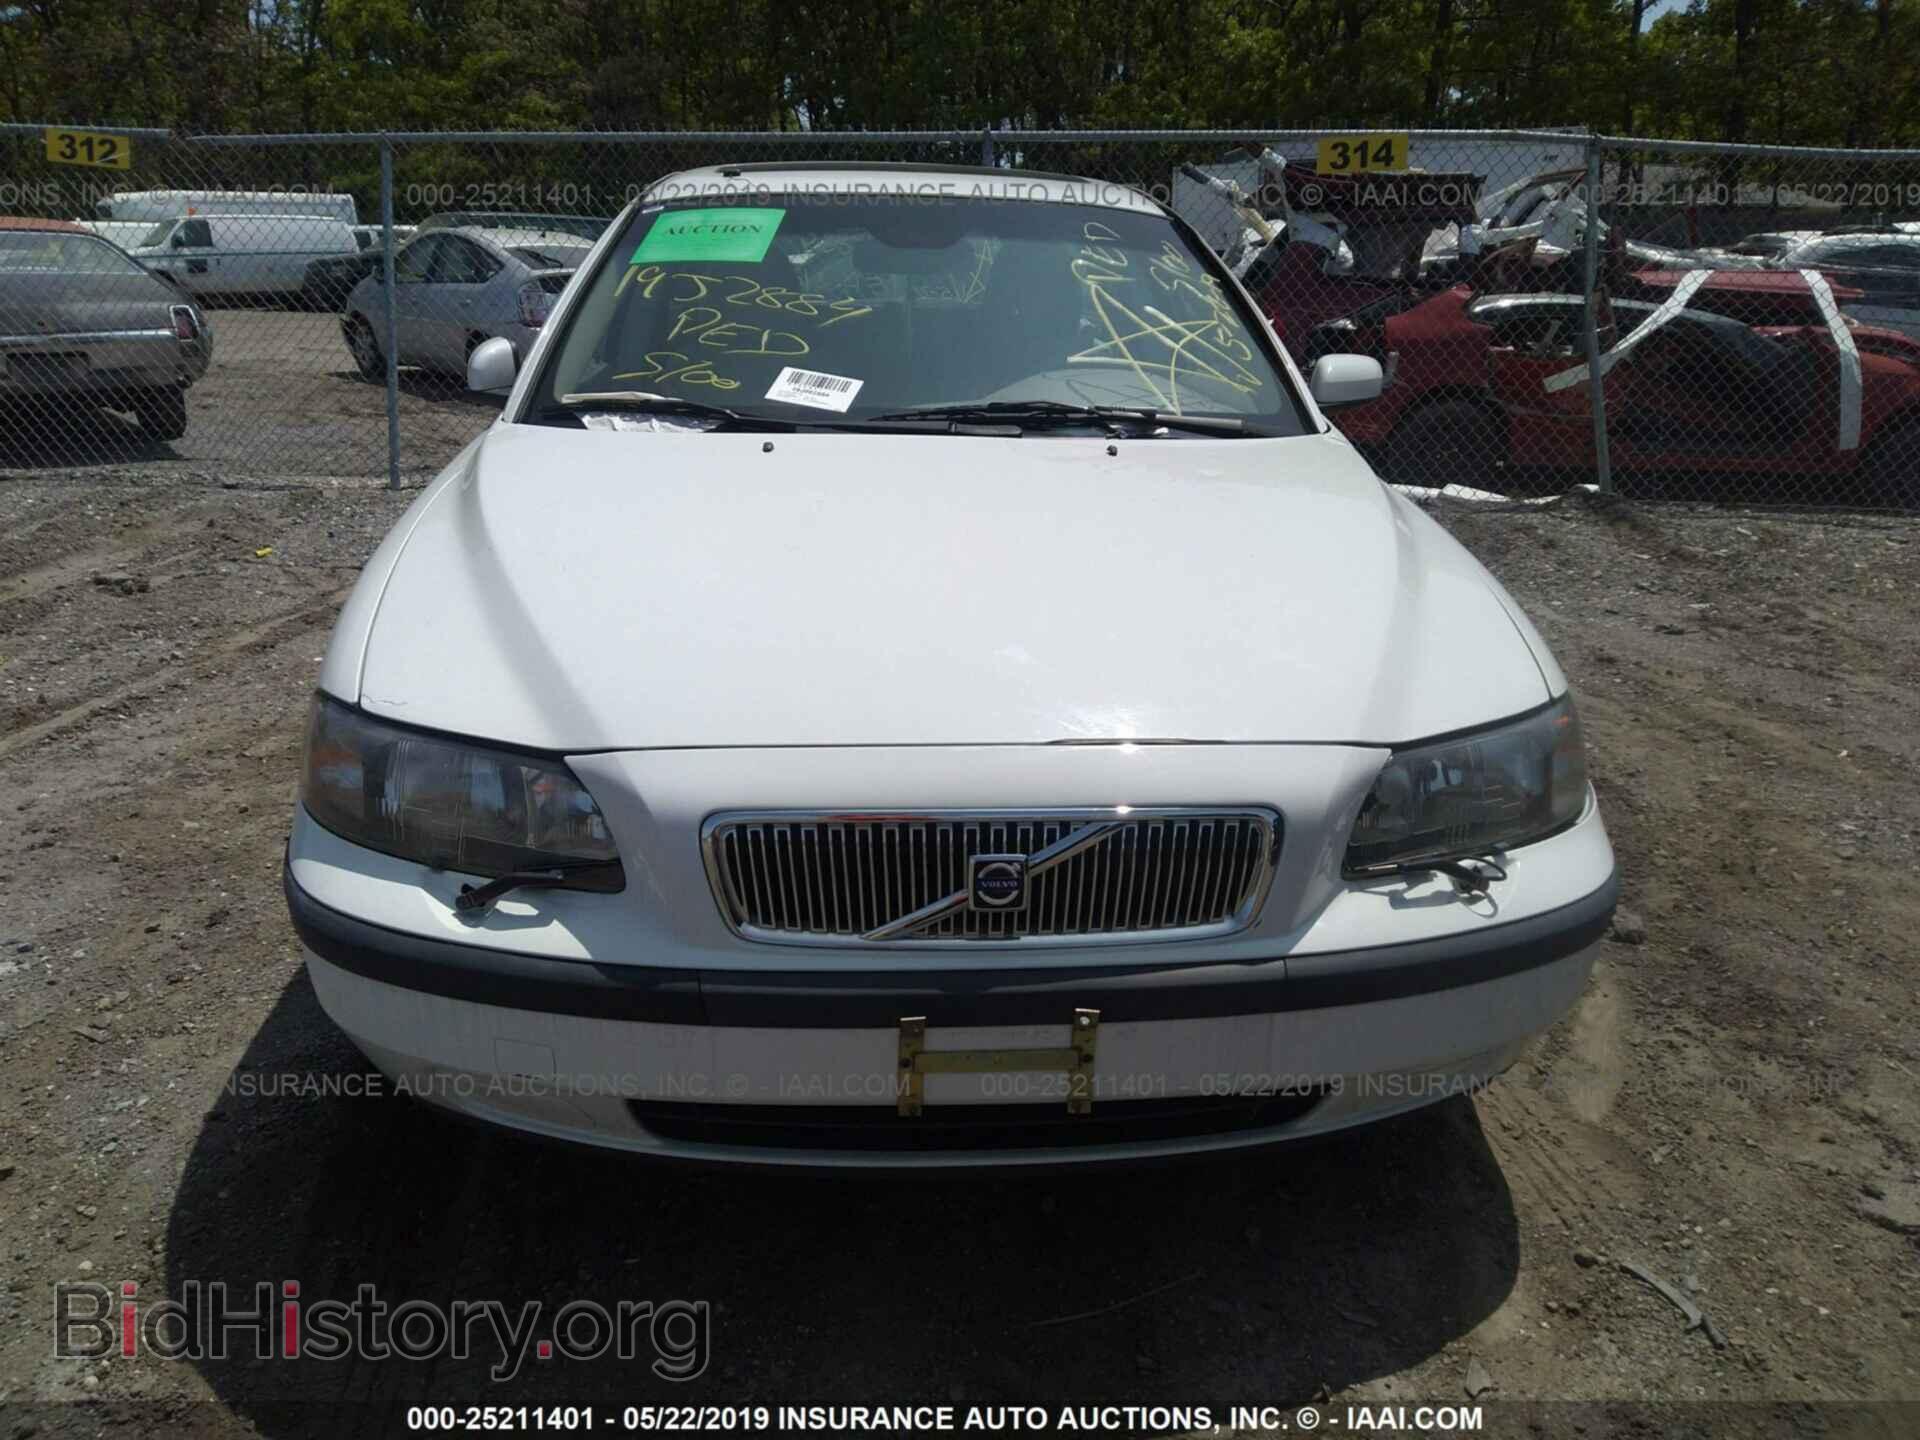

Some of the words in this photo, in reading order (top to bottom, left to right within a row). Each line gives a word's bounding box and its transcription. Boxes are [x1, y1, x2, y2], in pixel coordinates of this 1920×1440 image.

[58, 133, 118, 165] 312
[1329, 139, 1394, 170] 314
[664, 223, 763, 236] AUCTION
[981, 880, 1018, 889] VOLVO
